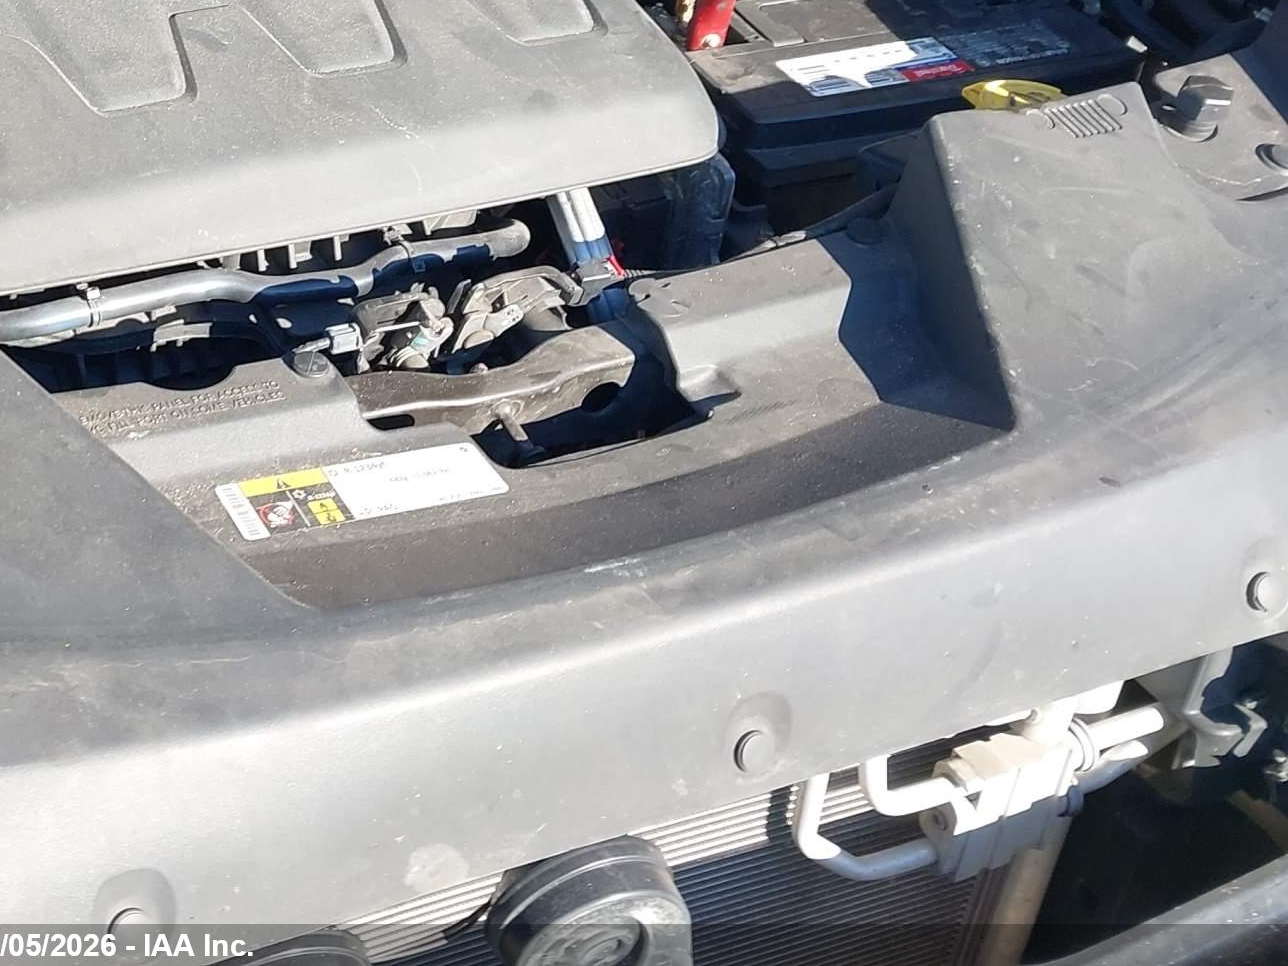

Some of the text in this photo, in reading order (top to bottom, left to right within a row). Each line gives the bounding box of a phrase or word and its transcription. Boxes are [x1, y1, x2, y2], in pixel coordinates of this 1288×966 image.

[136, 414, 167, 427] PORT
[170, 408, 189, 420] ON
[191, 401, 229, 417] SOME
[232, 391, 287, 411] VEHICLES
[150, 396, 191, 412] PANEL
[190, 392, 216, 405] FOR
[216, 384, 263, 401] ACCESS
[261, 379, 280, 391] TO
